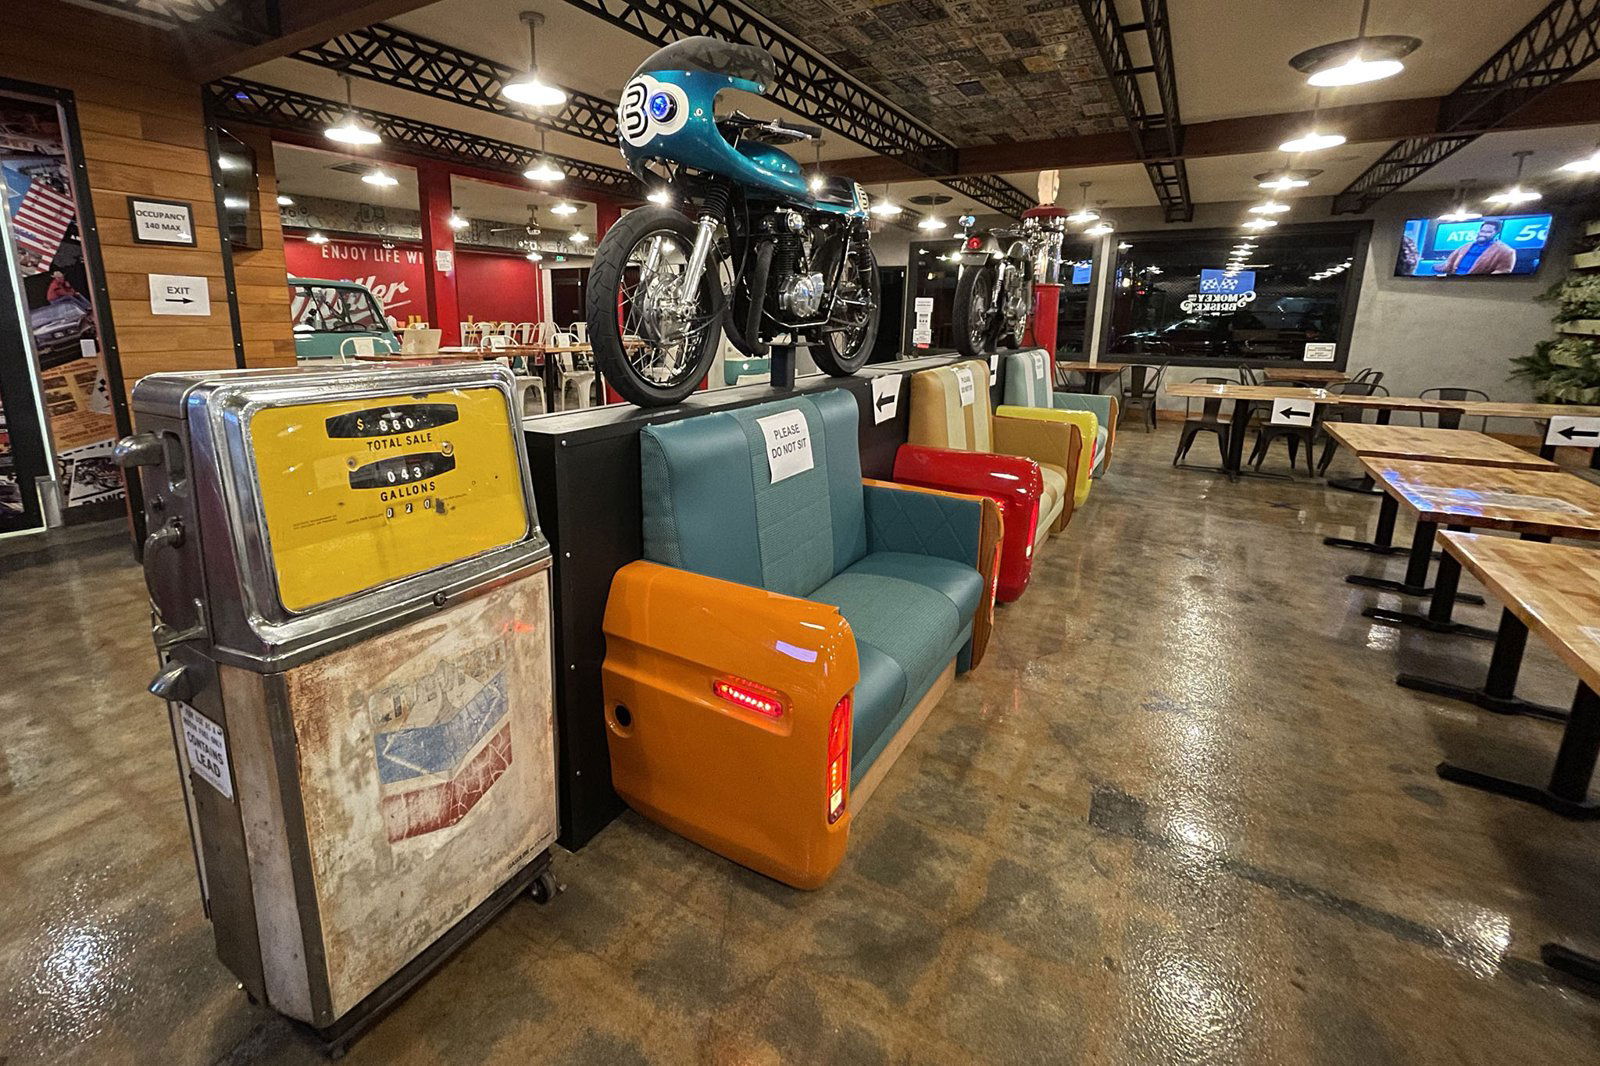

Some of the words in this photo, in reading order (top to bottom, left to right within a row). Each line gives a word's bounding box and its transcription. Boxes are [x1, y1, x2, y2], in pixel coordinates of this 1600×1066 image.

[136, 209, 186, 221] OCCUPANCY
[145, 221, 160, 230] 140
[322, 244, 367, 262] ENJOY
[374, 248, 400, 264] LIFE
[166, 286, 190, 295] EXIT
[357, 418, 365, 431] $
[774, 424, 800, 440] PLEASE
[367, 437, 402, 451] TOTAL
[406, 432, 433, 446] SALE
[771, 446, 783, 459] DO
[783, 441, 796, 454] NOT
[797, 438, 806, 449] SIT
[387, 466, 422, 483] 043
[380, 481, 436, 502] GALLONS
[195, 748, 221, 778] LEAD
